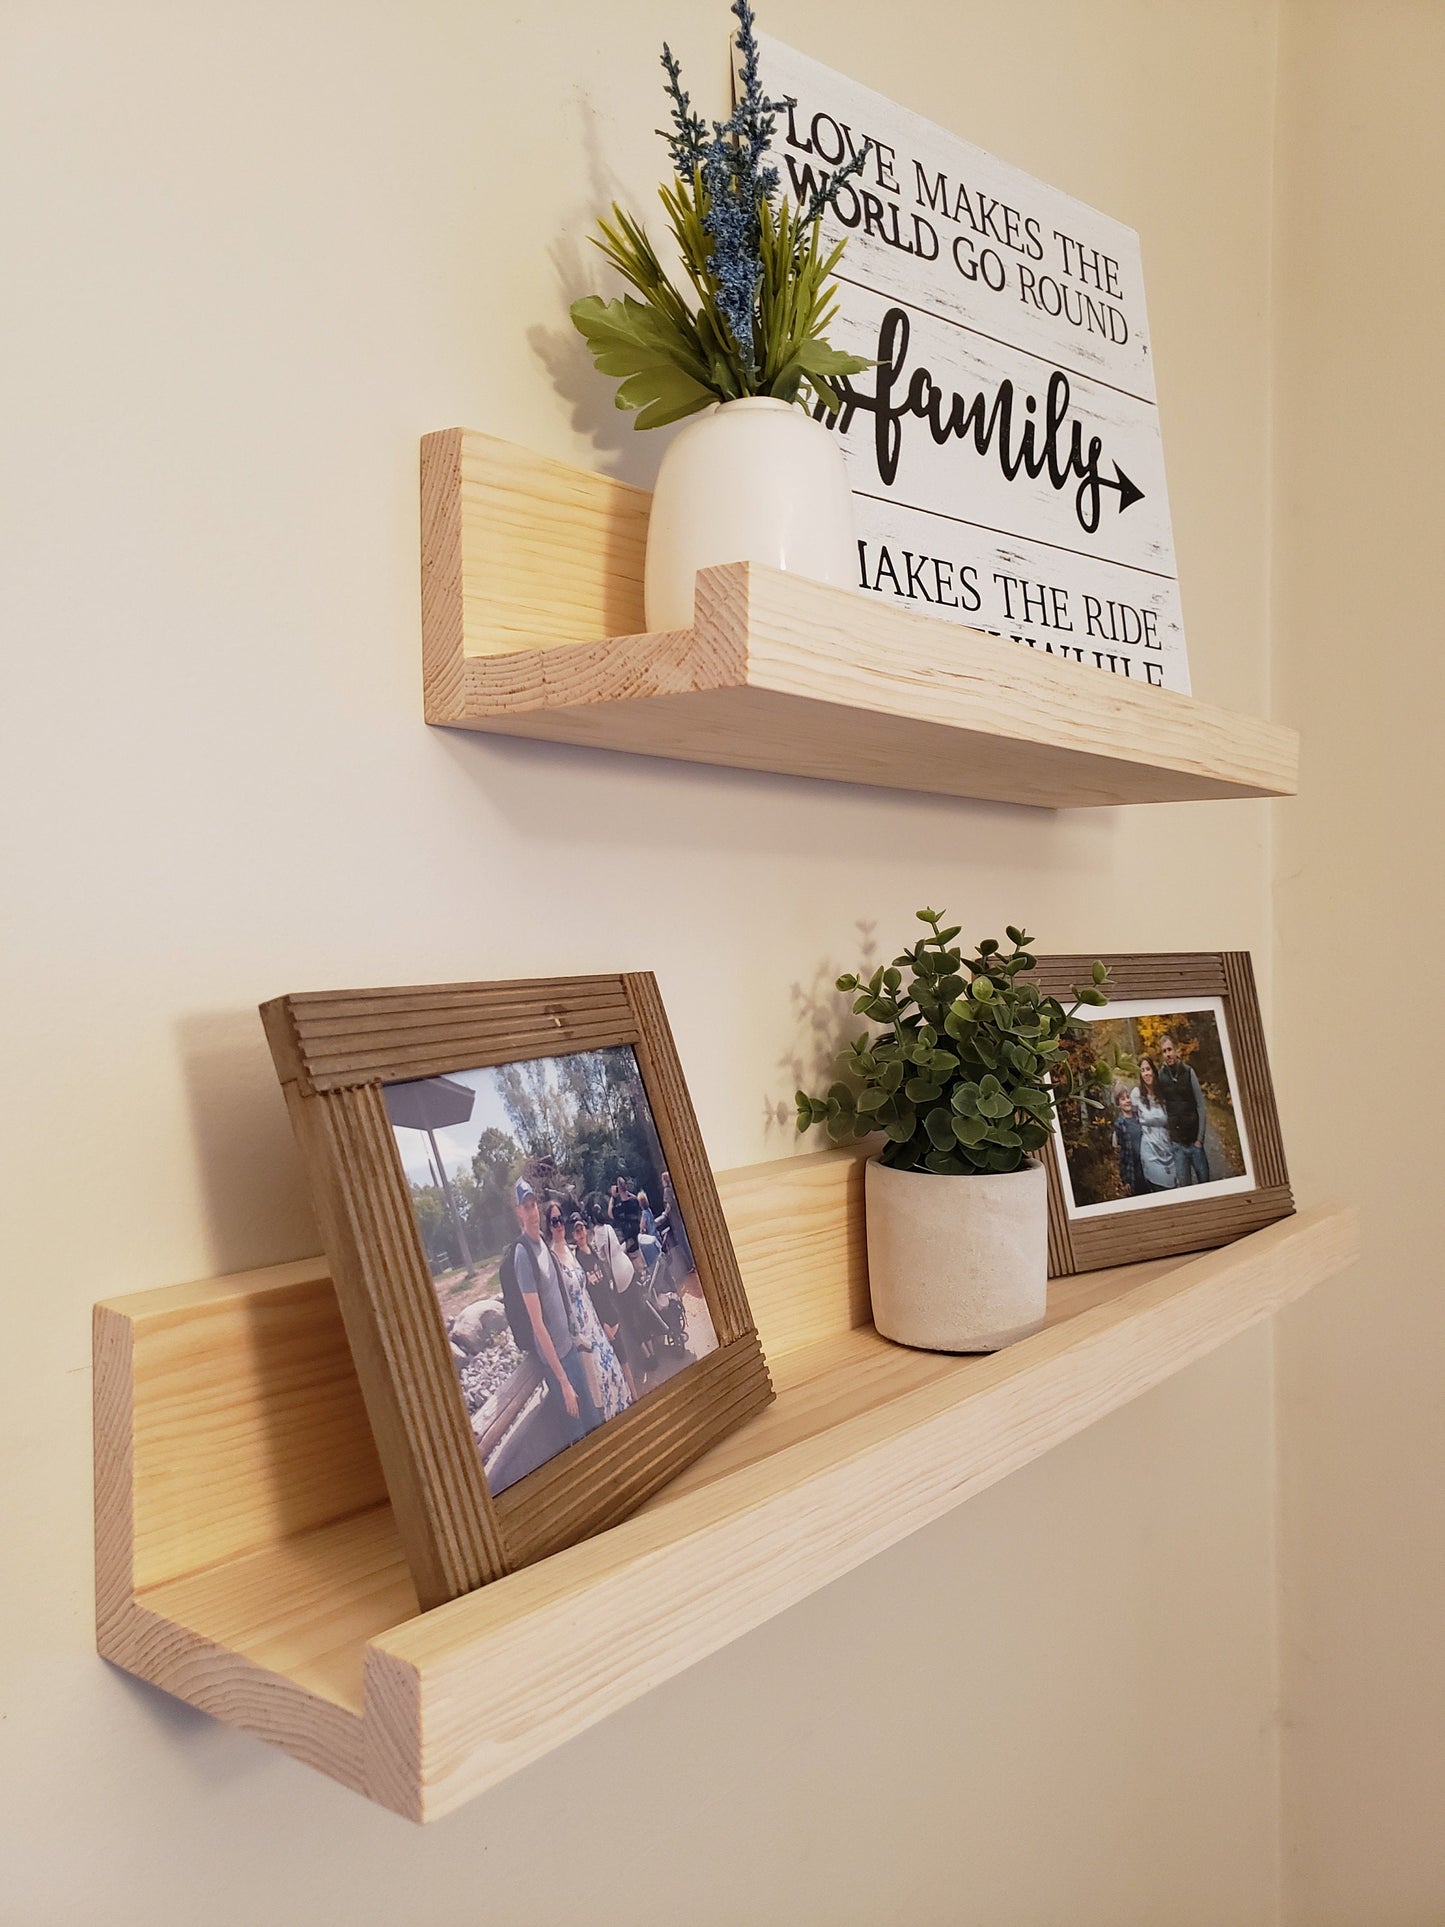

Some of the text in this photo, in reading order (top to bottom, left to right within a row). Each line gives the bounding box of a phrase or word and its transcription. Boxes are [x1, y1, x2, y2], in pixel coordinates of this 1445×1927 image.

[783, 94, 1123, 300] LOVE MAKES THE
[784, 154, 1128, 345] WORLD GO ROUND
[875, 307, 1103, 534] family
[993, 573, 1073, 631] THE
[1082, 594, 1163, 650] RIDE
